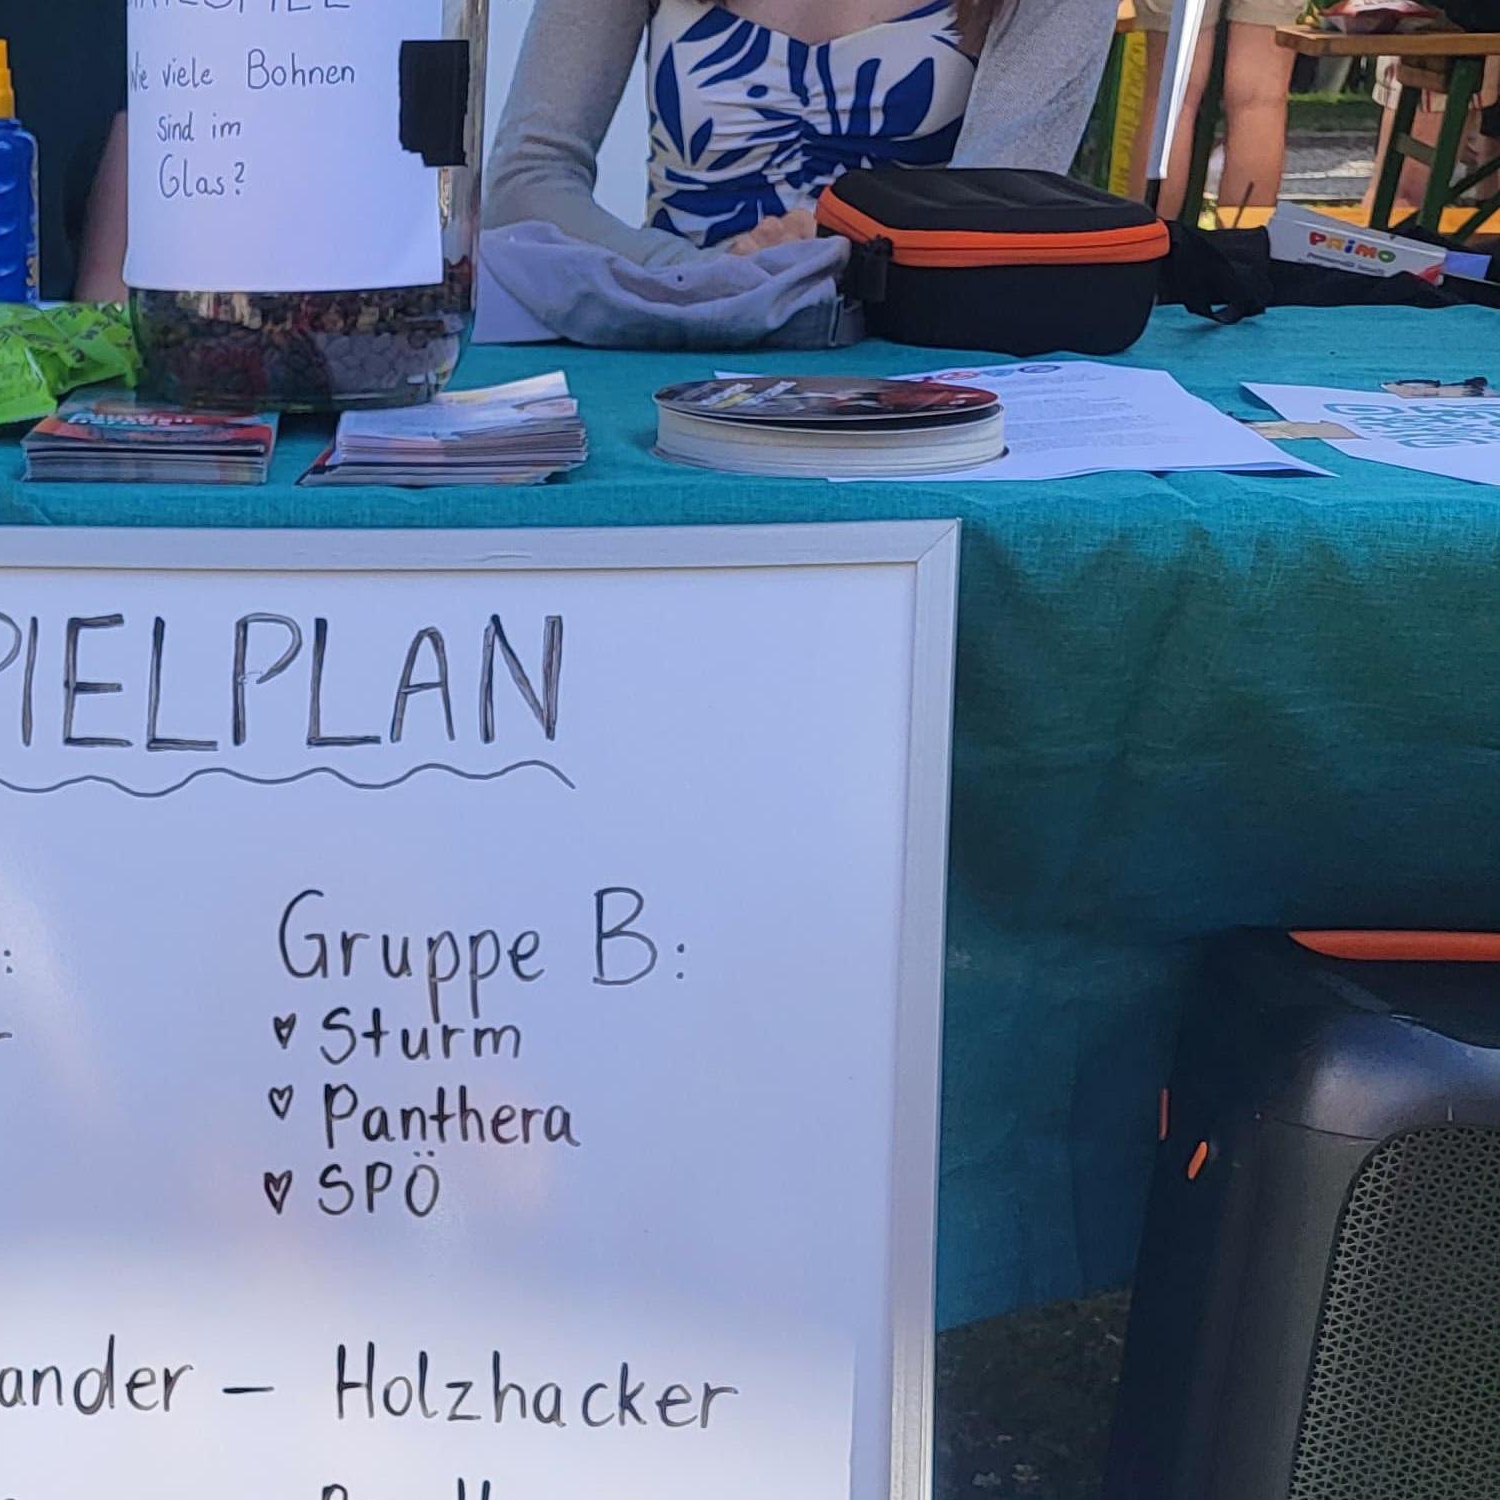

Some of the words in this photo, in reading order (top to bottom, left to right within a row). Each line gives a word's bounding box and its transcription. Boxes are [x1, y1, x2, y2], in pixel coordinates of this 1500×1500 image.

[162, 57, 214, 88] viele
[248, 49, 354, 89] Bohnen
[212, 112, 241, 139] im
[159, 153, 244, 198] Glas?
[278, 889, 544, 1023] Gruppe
[593, 887, 684, 986] B:
[320, 1004, 521, 1063] Sturm
[323, 1083, 580, 1153] Panthera
[318, 1149, 440, 1218] SPÖ
[336, 1341, 739, 1428] Holzhacker
